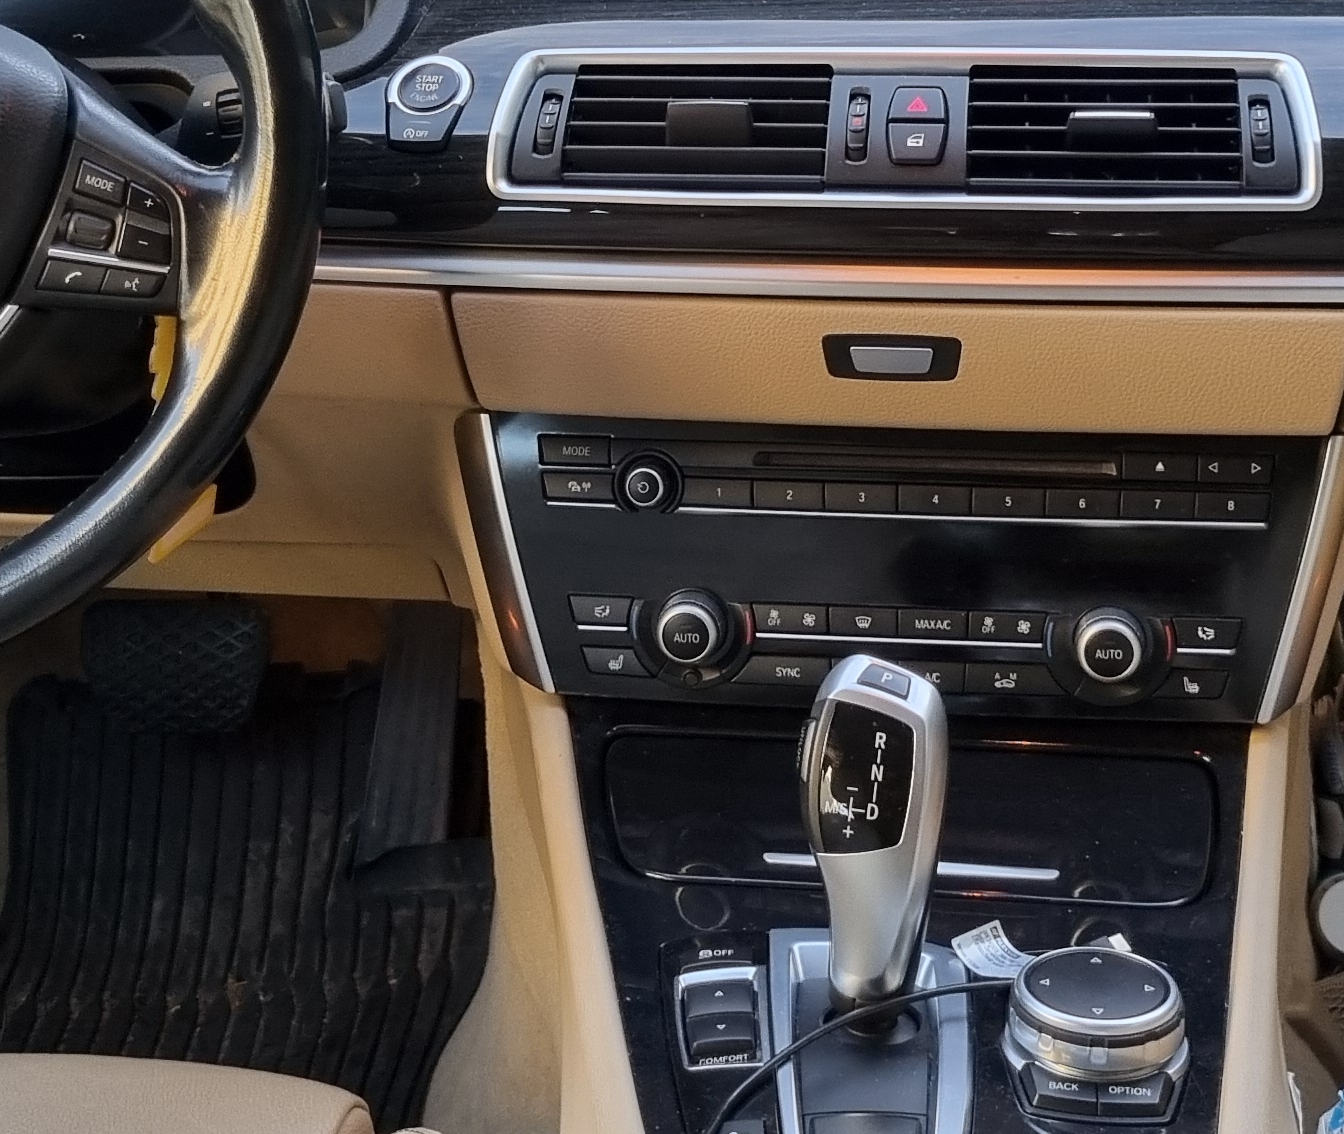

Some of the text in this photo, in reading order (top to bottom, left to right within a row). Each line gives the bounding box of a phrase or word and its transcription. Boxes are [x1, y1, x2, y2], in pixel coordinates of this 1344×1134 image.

[415, 74, 444, 83] START
[415, 83, 439, 92] STOP
[416, 129, 429, 138] OFF
[84, 174, 115, 192] MODE
[562, 446, 591, 457] MODE
[716, 487, 722, 498] 1
[786, 490, 793, 500] 2
[858, 492, 865, 503] 3
[932, 494, 939, 505] 4
[1005, 496, 1012, 507] 5
[1079, 498, 1086, 509] 6
[1154, 499, 1161, 510] 7
[1227, 501, 1235, 511] 8
[767, 618, 781, 626] OFF
[982, 626, 996, 634] OFF
[673, 633, 700, 644] AUTO
[1094, 649, 1123, 660] AUTO
[775, 667, 801, 678] SYNC
[880, 671, 893, 683] P
[924, 672, 941, 683] A/C
[874, 731, 887, 749] R
[871, 764, 884, 782] N
[866, 803, 879, 821] D
[1048, 1081, 1079, 1091] BACK
[1108, 1086, 1152, 1097] OPTION
